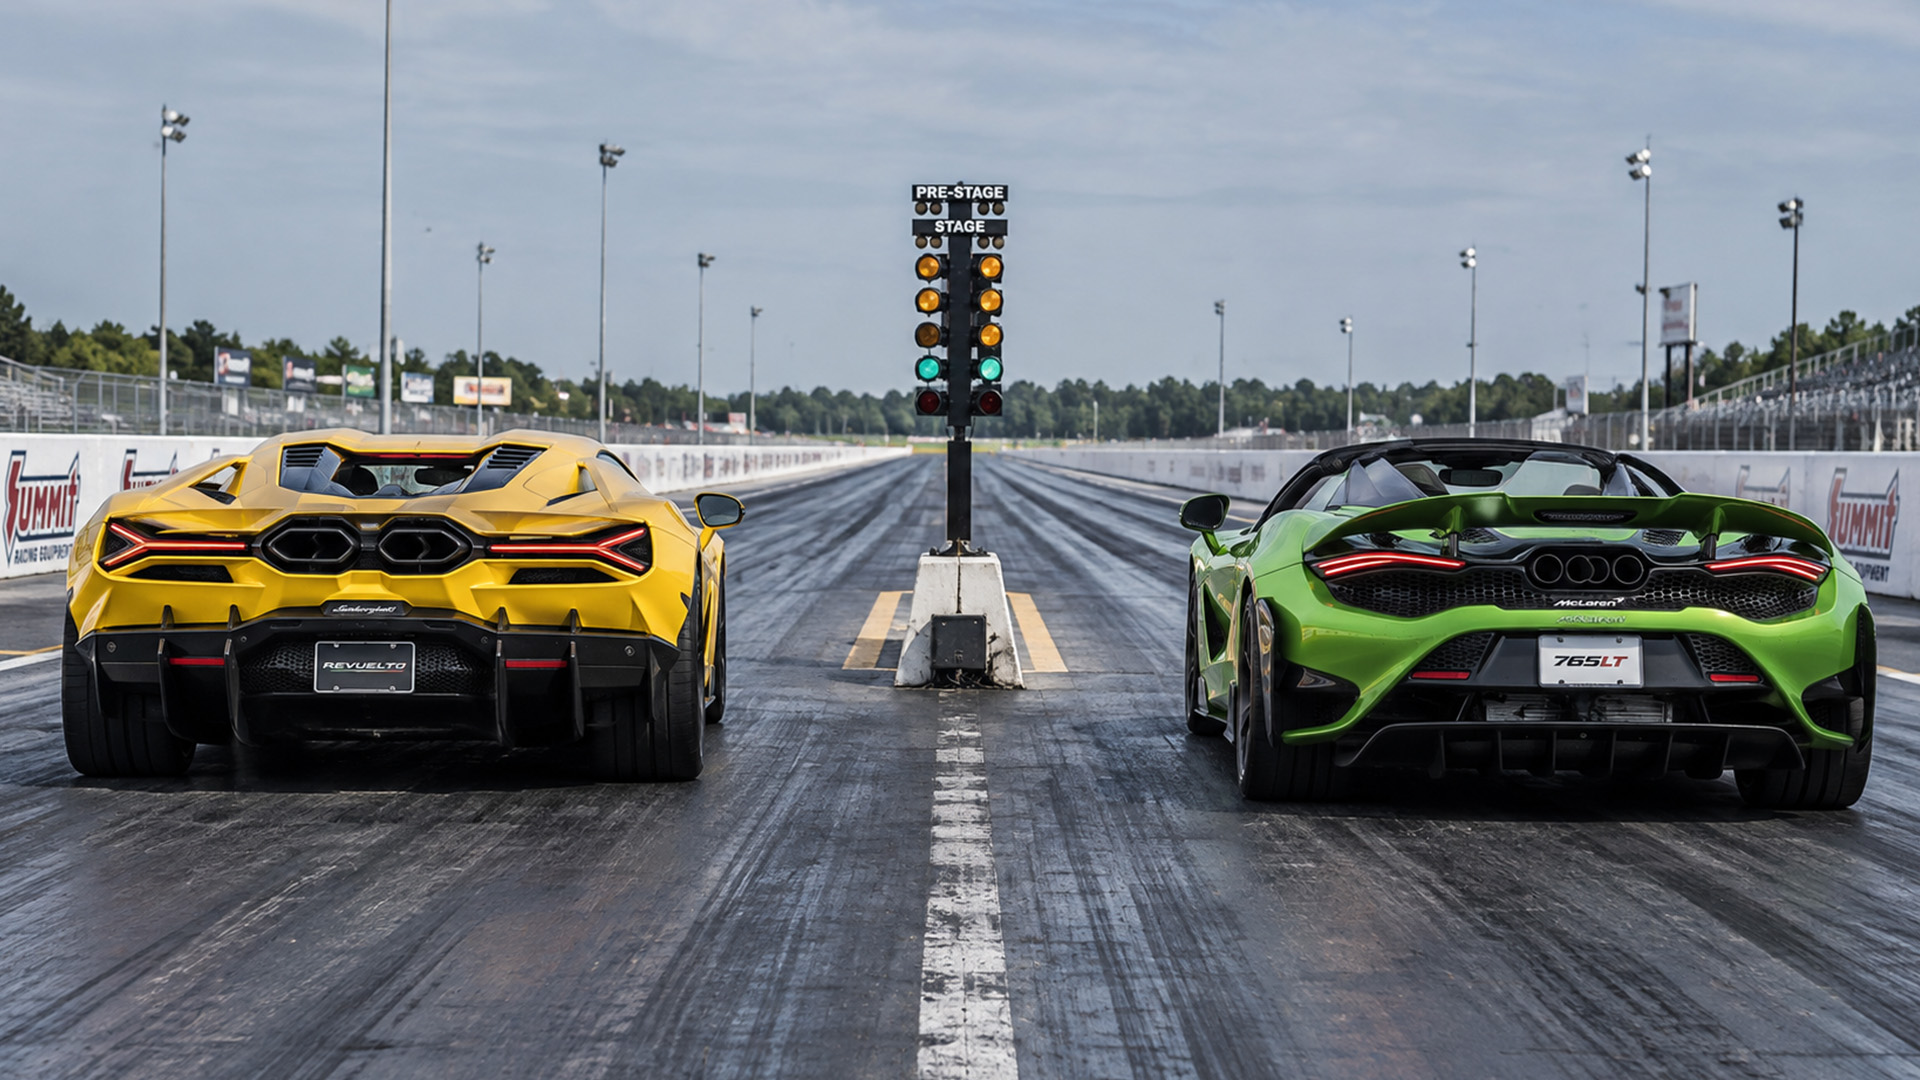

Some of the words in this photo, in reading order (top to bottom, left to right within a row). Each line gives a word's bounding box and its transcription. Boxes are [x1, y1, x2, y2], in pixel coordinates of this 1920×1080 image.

[916, 186, 1004, 199] PRE-STAGE
[934, 220, 986, 233] STAGE
[6, 459, 77, 546] SUMMIT
[1828, 477, 1896, 550] SUMMIT
[1554, 599, 1617, 607] McLaren
[322, 661, 407, 670] REVUELTO
[1554, 655, 1628, 668] 765LT
